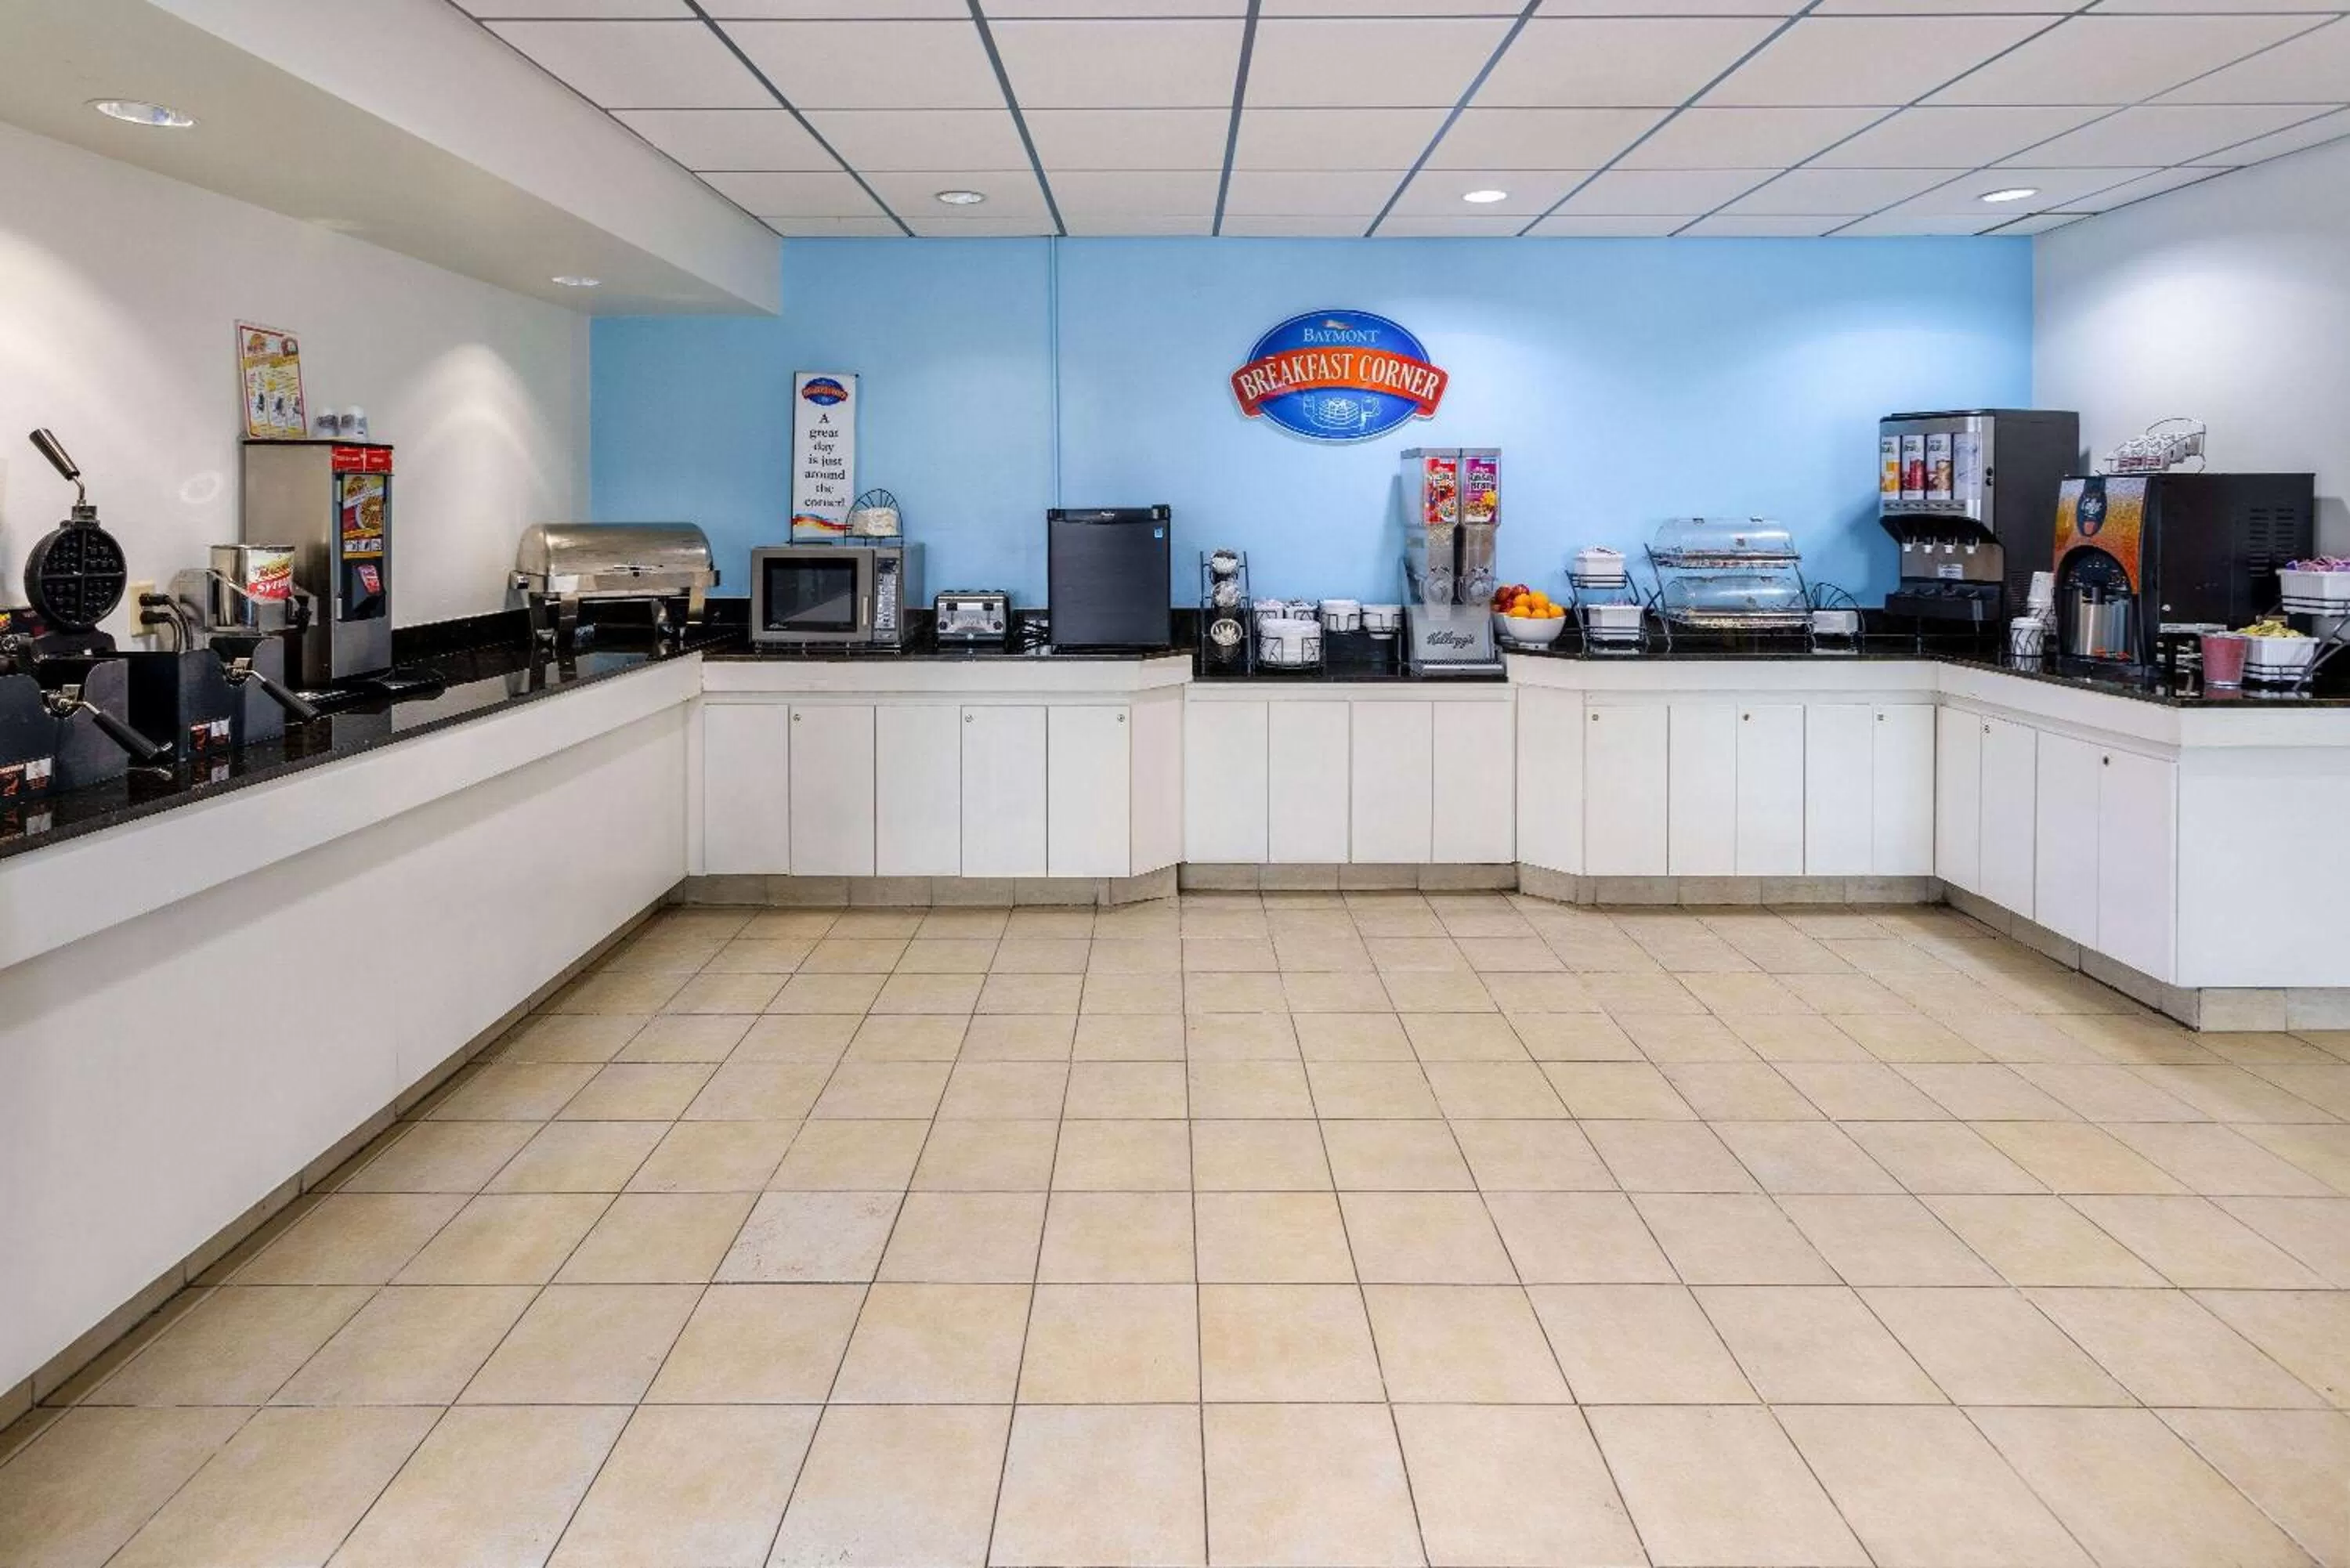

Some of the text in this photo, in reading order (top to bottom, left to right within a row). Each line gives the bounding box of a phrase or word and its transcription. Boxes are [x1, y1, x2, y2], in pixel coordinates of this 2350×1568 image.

[1303, 328, 1380, 343] BAYMONT
[1238, 353, 1440, 400] BREAKFAST CORNER
[819, 413, 830, 424] A
[809, 429, 839, 439] great
[814, 440, 835, 454] day
[808, 454, 843, 467] is just
[804, 469, 845, 480] around
[815, 483, 834, 493] the
[1426, 630, 1474, 649] Kellogg's
